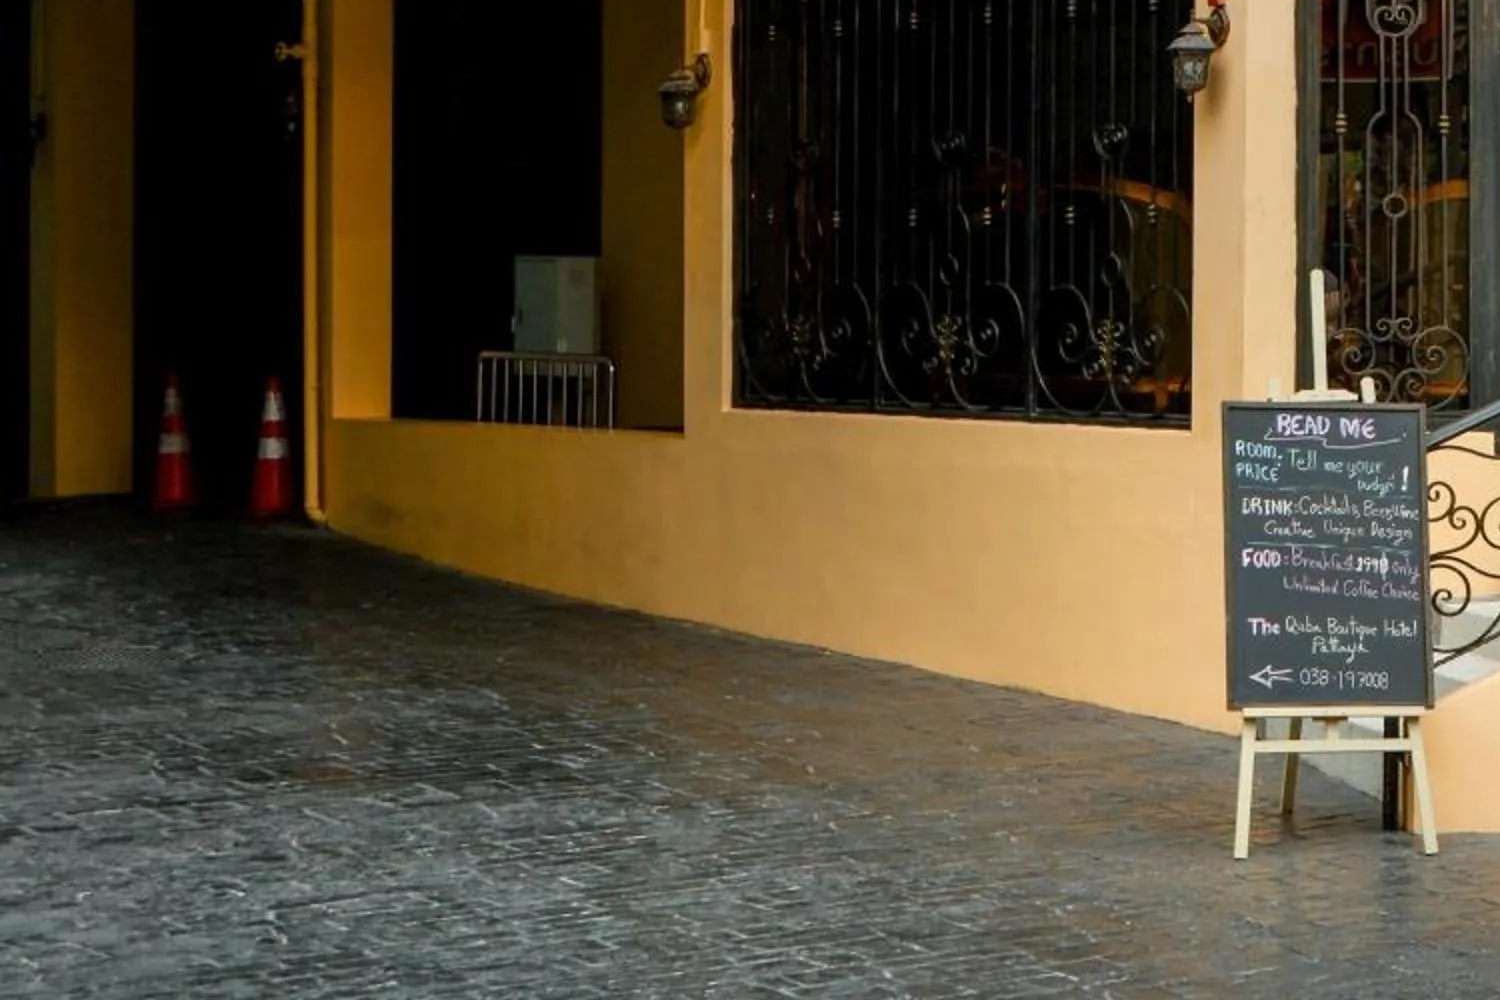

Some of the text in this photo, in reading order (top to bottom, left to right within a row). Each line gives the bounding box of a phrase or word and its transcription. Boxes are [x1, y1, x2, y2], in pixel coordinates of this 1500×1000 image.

[1276, 413, 1377, 439] READ ME
[1288, 448, 1383, 479] Tell me your
[1343, 578, 1379, 599] Coffee
[1248, 617, 1282, 636] The
[1285, 615, 1323, 635] Quba
[1383, 619, 1418, 638] Hotel
